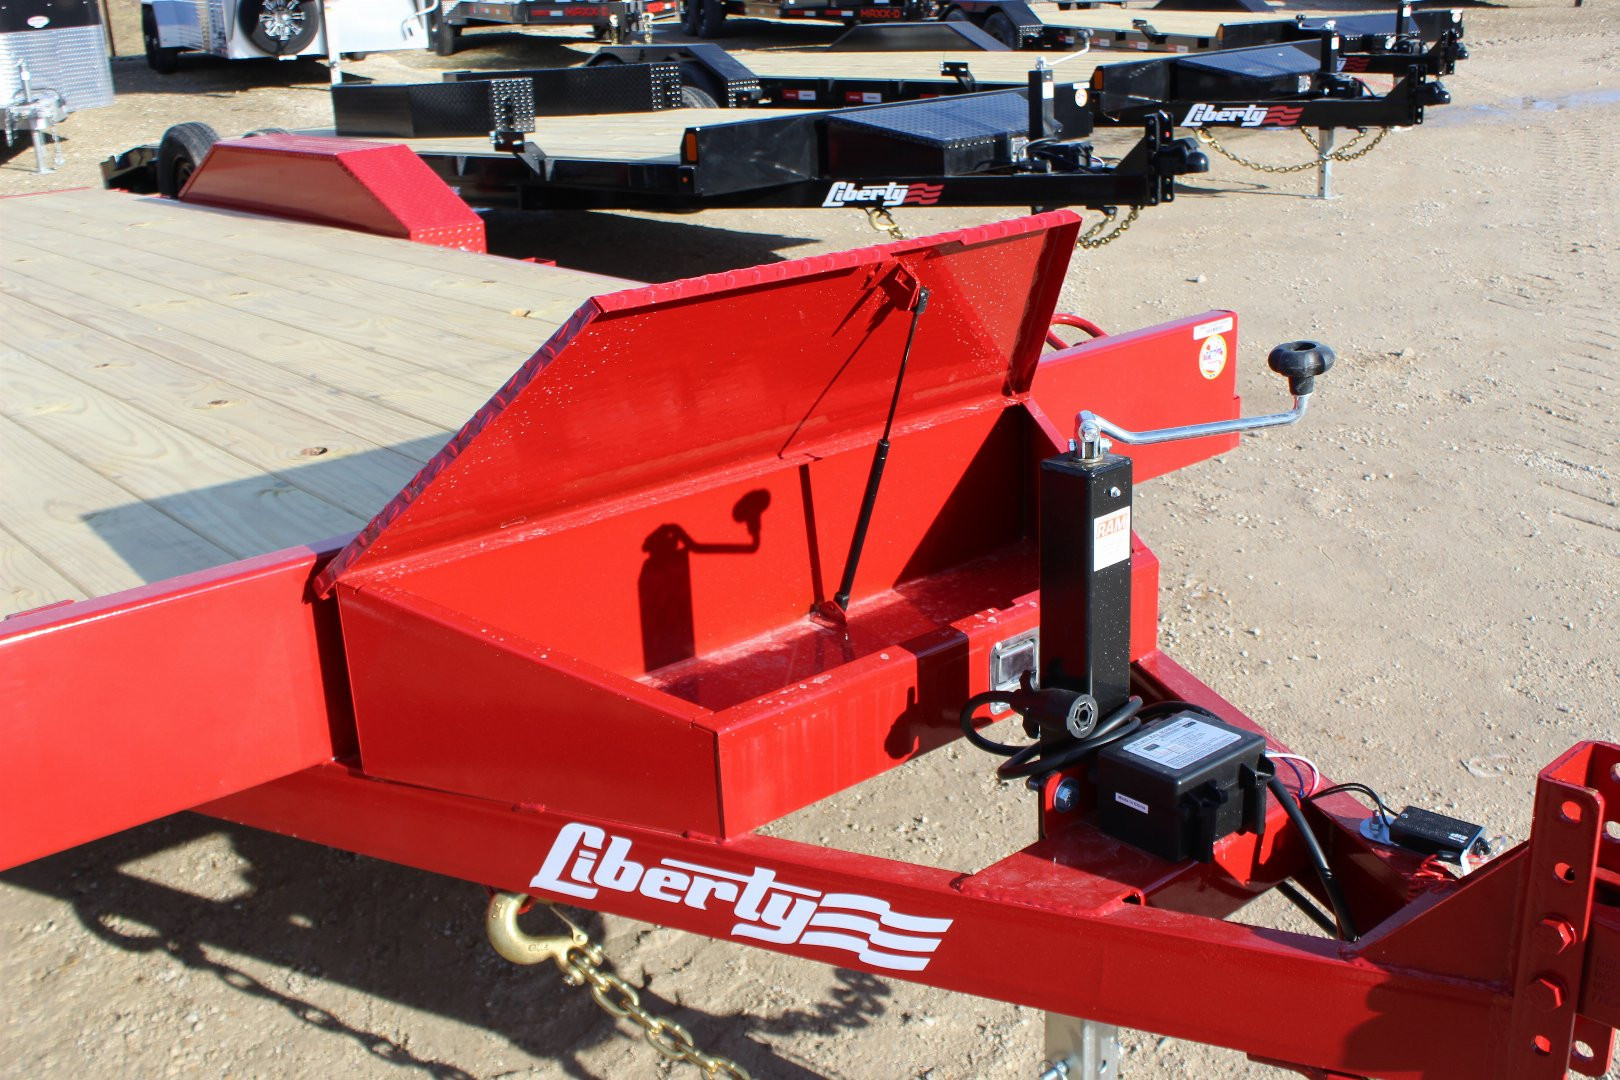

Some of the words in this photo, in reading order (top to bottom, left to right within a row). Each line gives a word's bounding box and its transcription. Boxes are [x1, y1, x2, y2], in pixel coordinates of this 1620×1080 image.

[1180, 103, 1268, 127] Liberty
[822, 181, 909, 207] Liberty
[1096, 513, 1128, 539] RAM
[529, 822, 821, 945] Liberty
